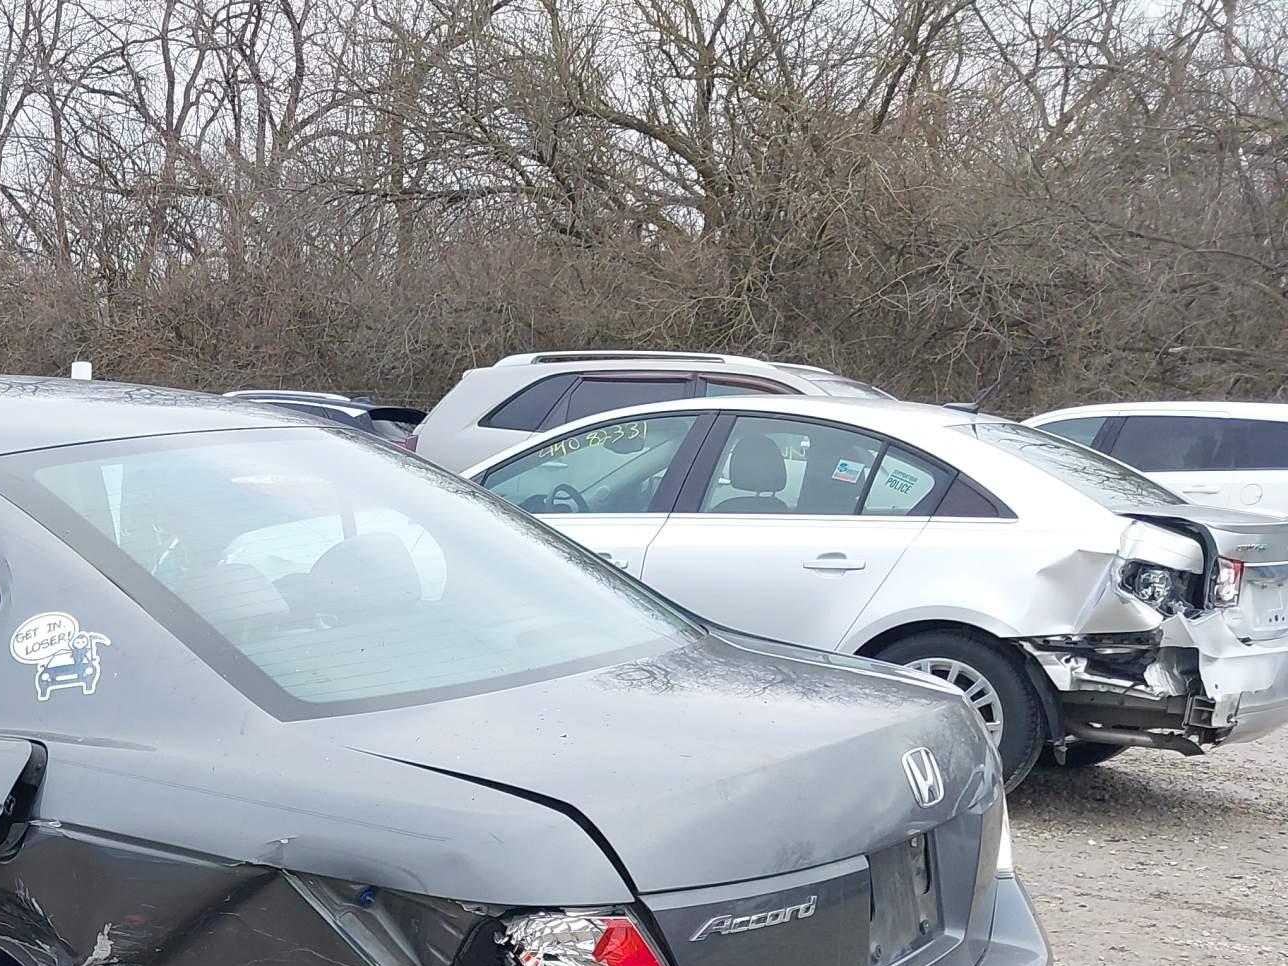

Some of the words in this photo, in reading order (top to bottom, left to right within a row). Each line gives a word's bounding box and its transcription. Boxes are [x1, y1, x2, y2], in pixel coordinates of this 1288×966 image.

[885, 477, 912, 494] POLICE
[15, 627, 40, 643] GET
[25, 631, 72, 656] LOSER!
[688, 895, 818, 942] Accord
